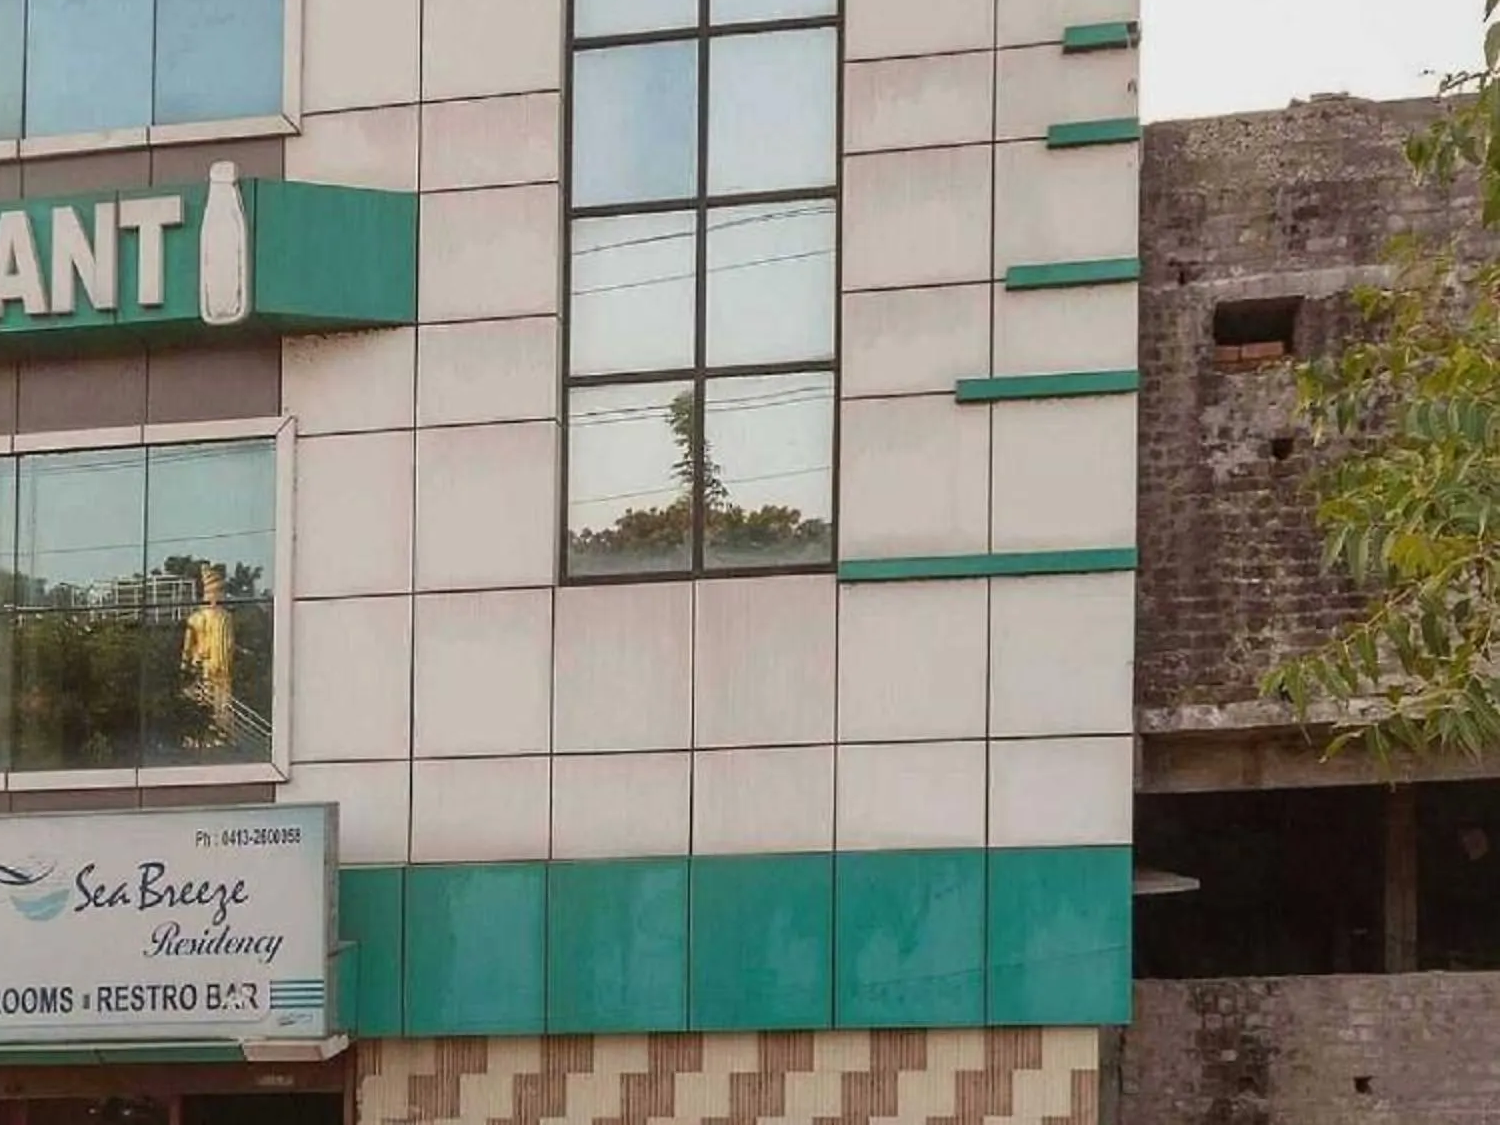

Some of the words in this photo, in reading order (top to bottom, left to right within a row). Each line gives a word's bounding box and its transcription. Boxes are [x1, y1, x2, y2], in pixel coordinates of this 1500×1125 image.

[74, 863, 130, 912] Sea
[137, 862, 248, 925] Breeze
[143, 920, 283, 964] Residency
[97, 983, 196, 1012] RESTRO
